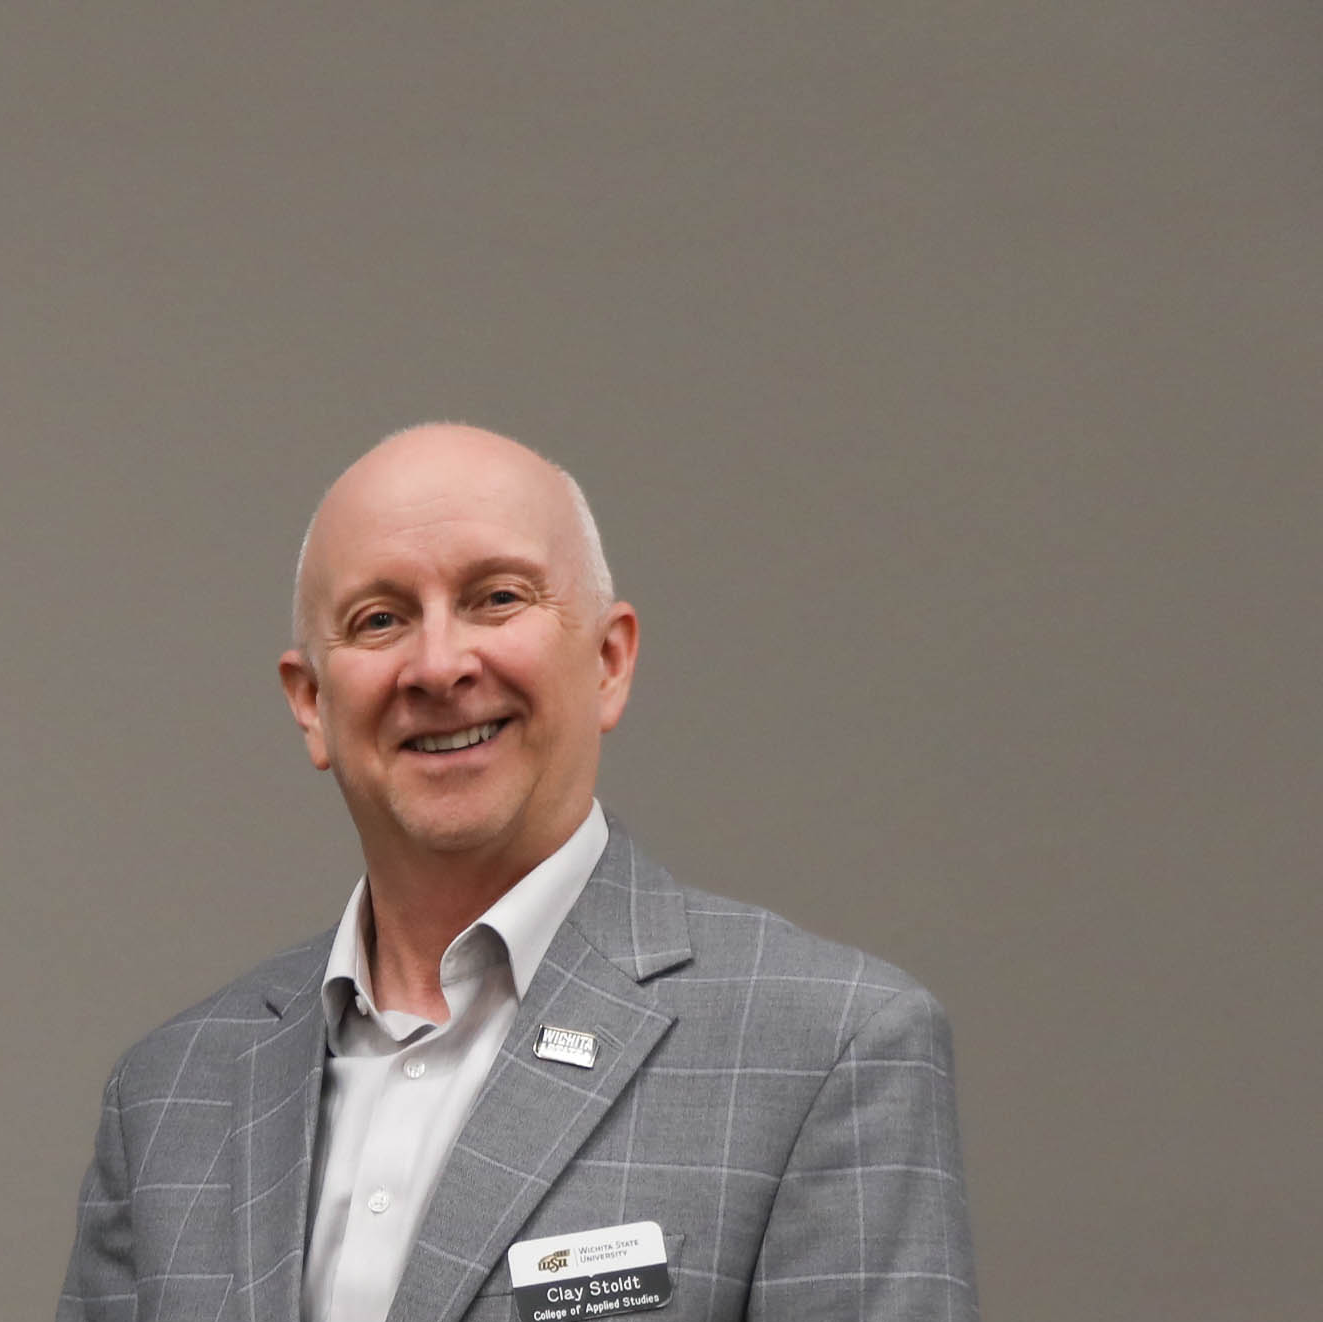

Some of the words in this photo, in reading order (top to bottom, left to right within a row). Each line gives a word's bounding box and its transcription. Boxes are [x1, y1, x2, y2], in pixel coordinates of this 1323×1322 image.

[578, 1244, 613, 1255] WICHITA
[615, 1239, 639, 1249] STATE
[580, 1250, 628, 1264] UNIVERSITY
[546, 1286, 584, 1302] Clay
[589, 1275, 641, 1296] Stoldt
[533, 1308, 567, 1321] College
[570, 1305, 581, 1315] of
[585, 1298, 620, 1314] Applied
[623, 1293, 660, 1307] Studies
